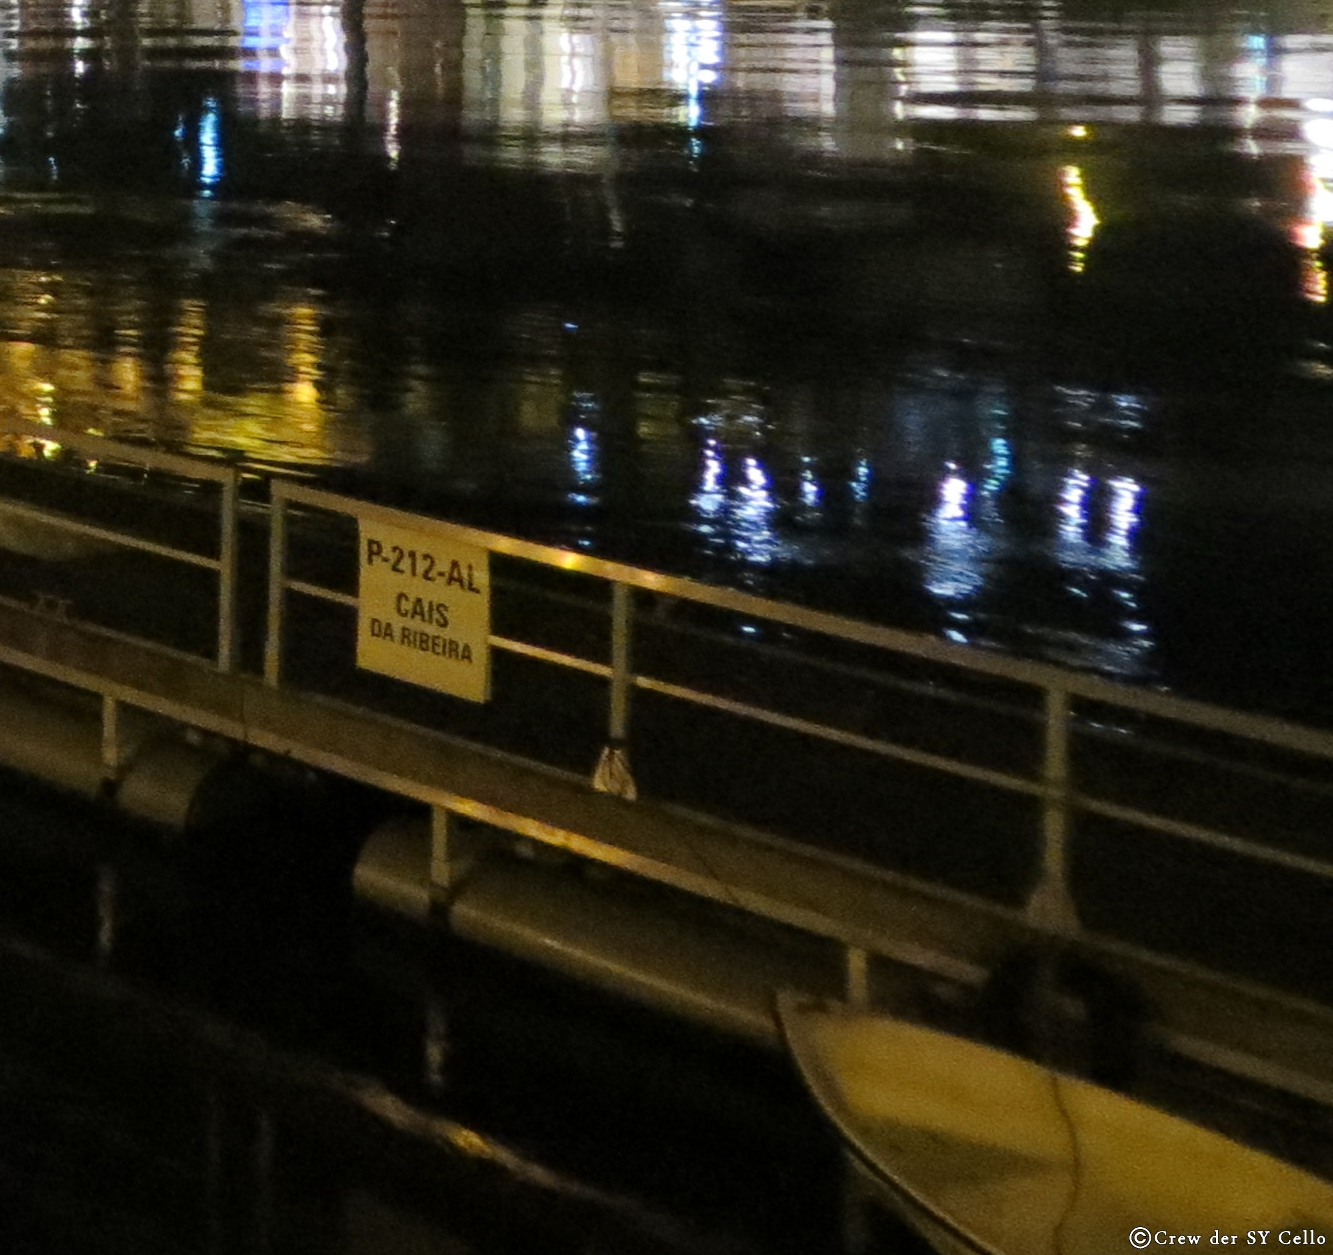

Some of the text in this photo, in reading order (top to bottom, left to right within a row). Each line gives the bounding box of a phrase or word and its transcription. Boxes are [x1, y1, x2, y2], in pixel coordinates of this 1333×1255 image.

[367, 538, 481, 594] P-212-AL
[396, 592, 449, 629] CAIS
[370, 618, 473, 664] DA RIBEIRA
